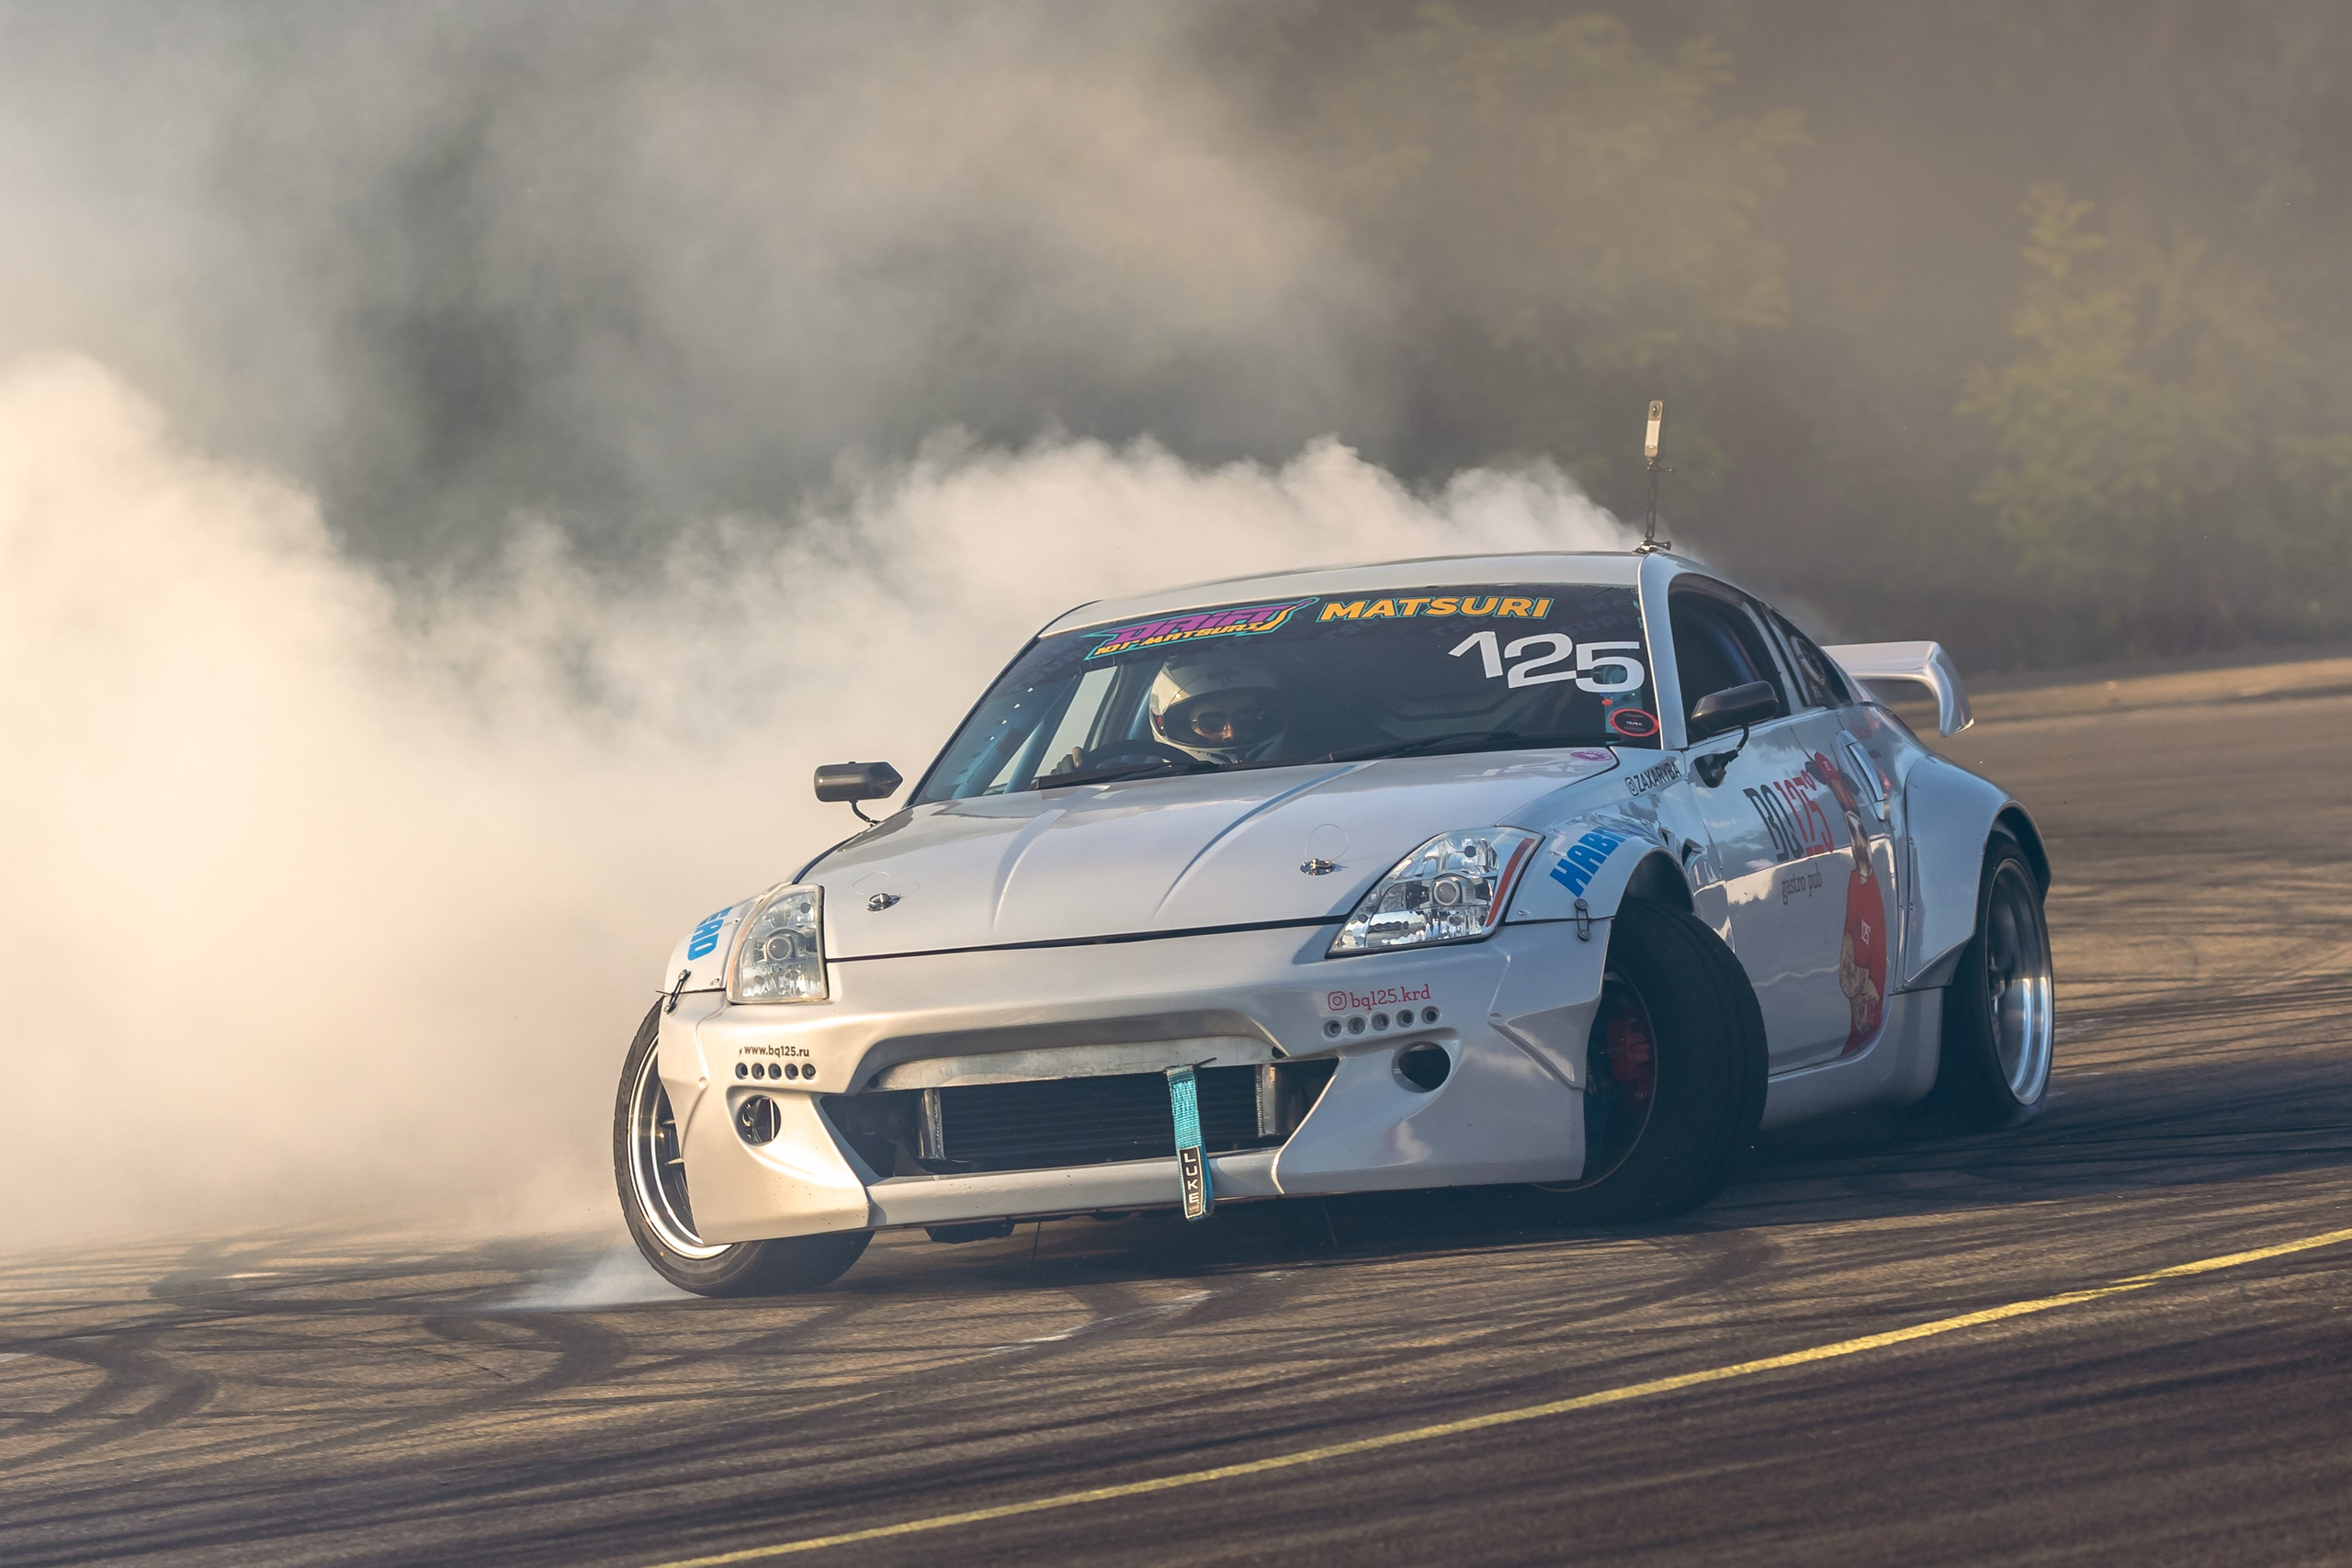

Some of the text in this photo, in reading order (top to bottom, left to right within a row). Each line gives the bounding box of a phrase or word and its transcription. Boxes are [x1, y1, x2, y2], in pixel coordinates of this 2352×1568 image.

[1319, 597, 1551, 620] MATSURI
[1448, 631, 1645, 693] 125
[1781, 862, 1823, 906] gastro pub
[1350, 983, 1431, 1011] bq125.krd
[743, 1044, 810, 1058] www.bq125.ru
[1183, 1152, 1200, 1204] LUKE
